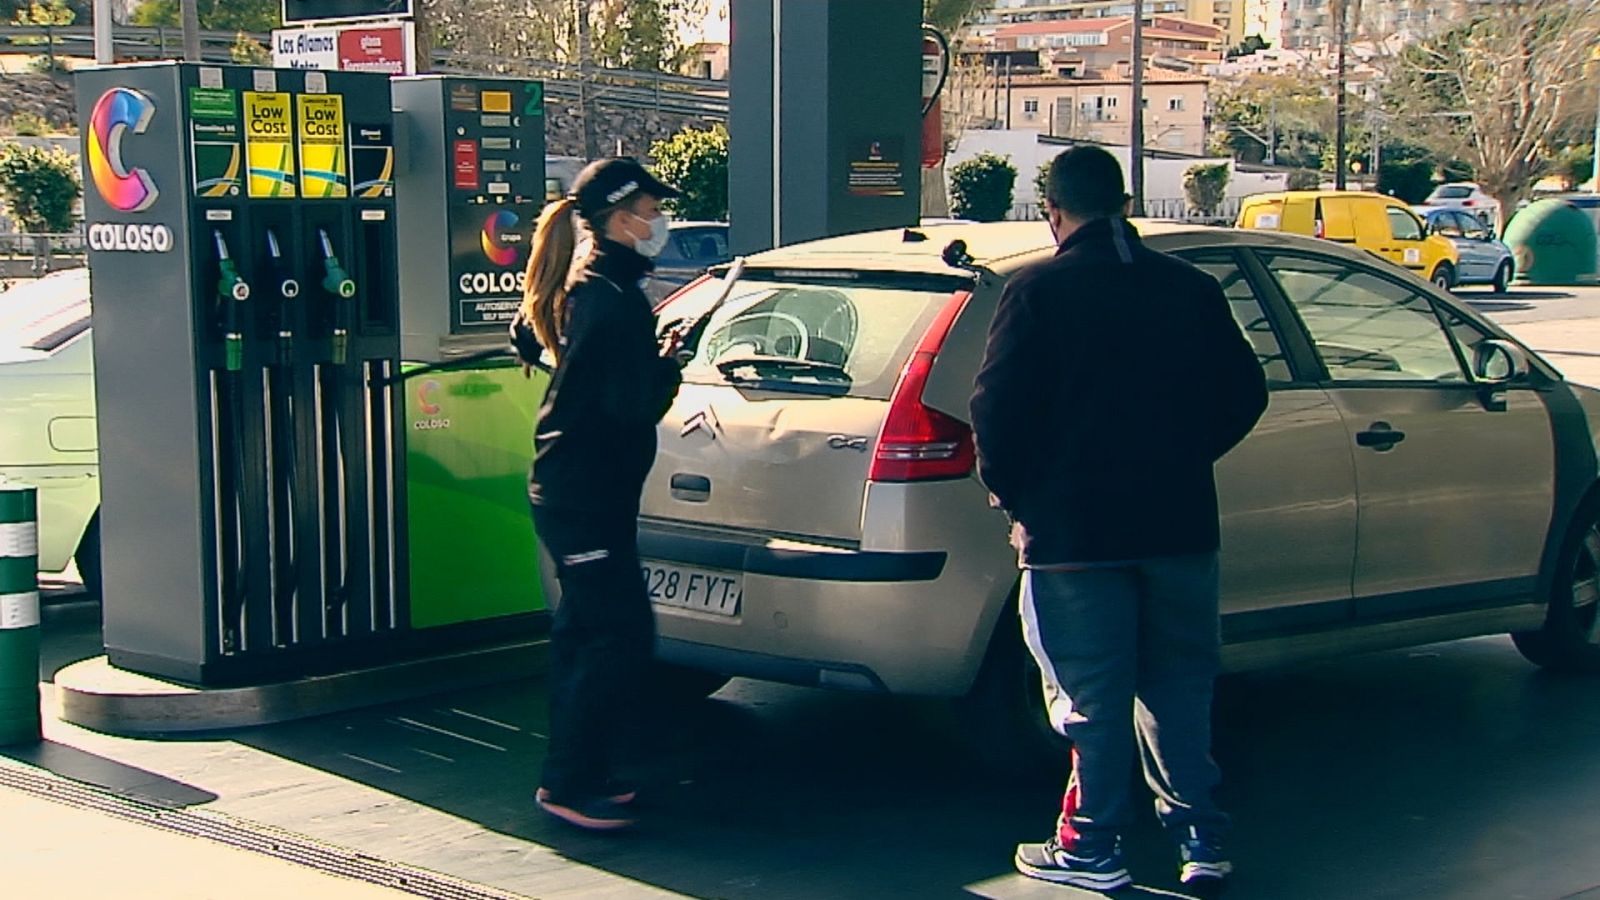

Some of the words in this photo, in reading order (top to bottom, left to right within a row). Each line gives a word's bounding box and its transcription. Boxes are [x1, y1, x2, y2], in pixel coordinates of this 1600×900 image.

[278, 35, 294, 54] Los
[524, 82, 543, 116] 2
[251, 103, 284, 119] Low
[305, 106, 336, 121] Low
[250, 119, 287, 134] Cost
[304, 120, 340, 136] Cost
[88, 222, 173, 252] COLOSO
[459, 271, 526, 294] COLOS
[475, 301, 523, 312] AUTOSERVIC
[827, 433, 868, 453] C4
[684, 573, 736, 609] FYT
